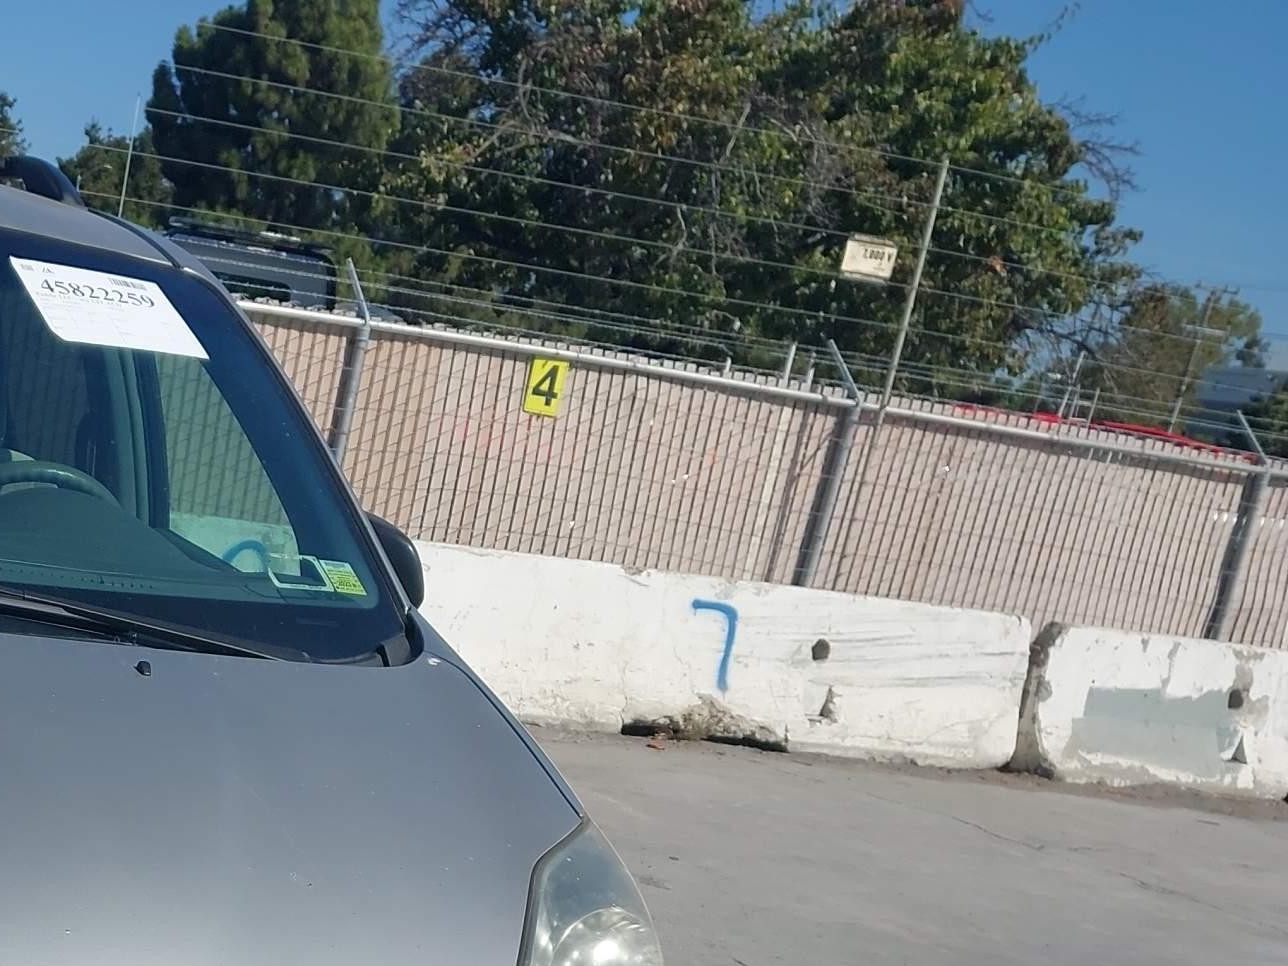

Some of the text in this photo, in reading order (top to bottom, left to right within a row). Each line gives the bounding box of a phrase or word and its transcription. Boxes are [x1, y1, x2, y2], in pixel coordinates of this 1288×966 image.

[40, 278, 155, 308] 45822259
[531, 364, 560, 407] 4
[692, 599, 738, 692] 7
